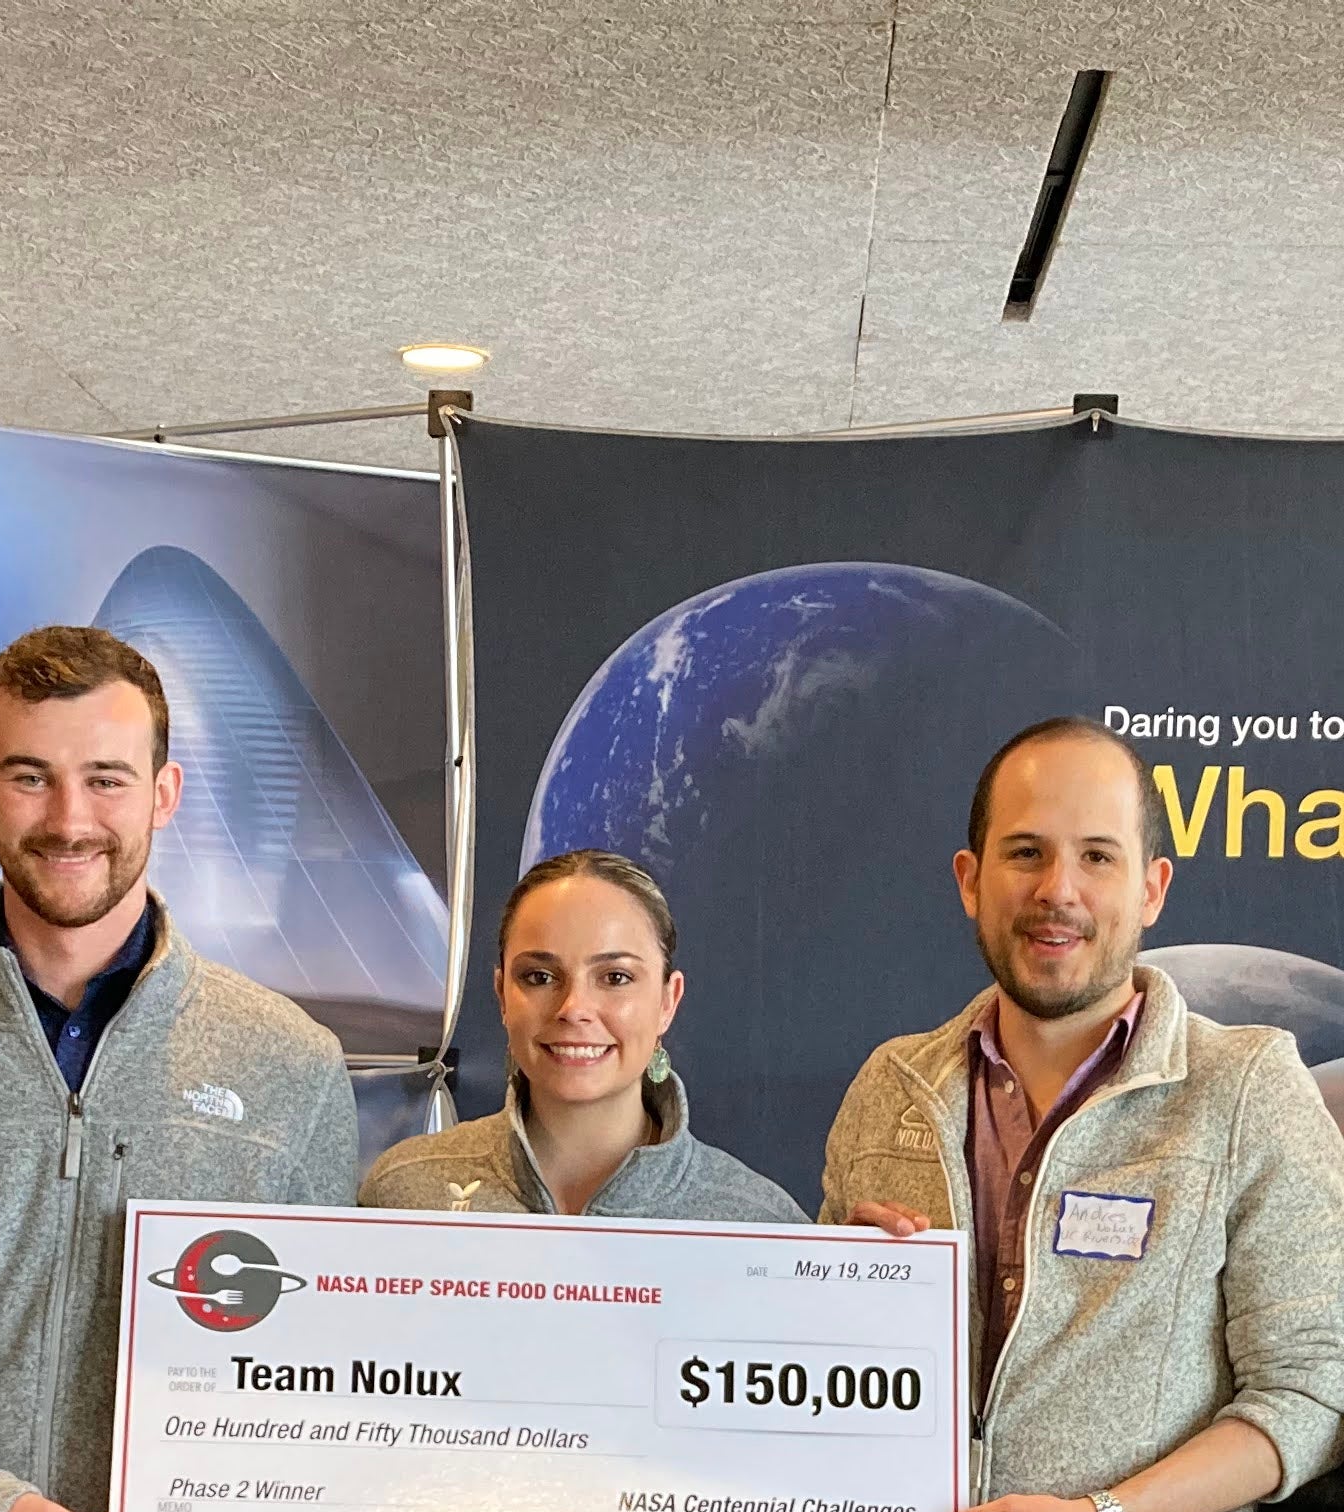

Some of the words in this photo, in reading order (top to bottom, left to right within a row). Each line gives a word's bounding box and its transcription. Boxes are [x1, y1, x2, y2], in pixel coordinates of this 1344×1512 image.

[1104, 705, 1220, 746] Daring
[1231, 714, 1298, 747] you
[182, 1088, 226, 1108] NORTH
[202, 1082, 226, 1097] THE
[192, 1101, 224, 1116] FACE
[746, 1266, 768, 1278] DATE
[794, 1260, 832, 1281] May
[837, 1262, 861, 1282] 19,
[867, 1263, 912, 1281] 2023
[316, 1275, 368, 1294] NASA
[375, 1277, 423, 1295] DEEP
[430, 1279, 491, 1298] SPACE
[497, 1282, 546, 1300] FOOD
[553, 1284, 662, 1304] CHALLENGE
[167, 1366, 184, 1377] PAY
[184, 1367, 198, 1377] TO
[199, 1367, 217, 1378] THE
[230, 1355, 334, 1393] Team
[350, 1360, 463, 1397] Nolux
[168, 1381, 202, 1392] ORDER
[203, 1382, 216, 1393] OF
[679, 1355, 922, 1416] $150,000
[164, 1415, 206, 1437] One
[212, 1417, 306, 1440] Hundred
[309, 1421, 350, 1442] and
[355, 1421, 404, 1447] Fifty
[409, 1423, 511, 1447] Thousand
[516, 1427, 590, 1449] Dollars
[168, 1478, 231, 1499] Phase
[235, 1480, 250, 1499] 2
[256, 1480, 326, 1501] Winner
[617, 1491, 676, 1512] NASA
